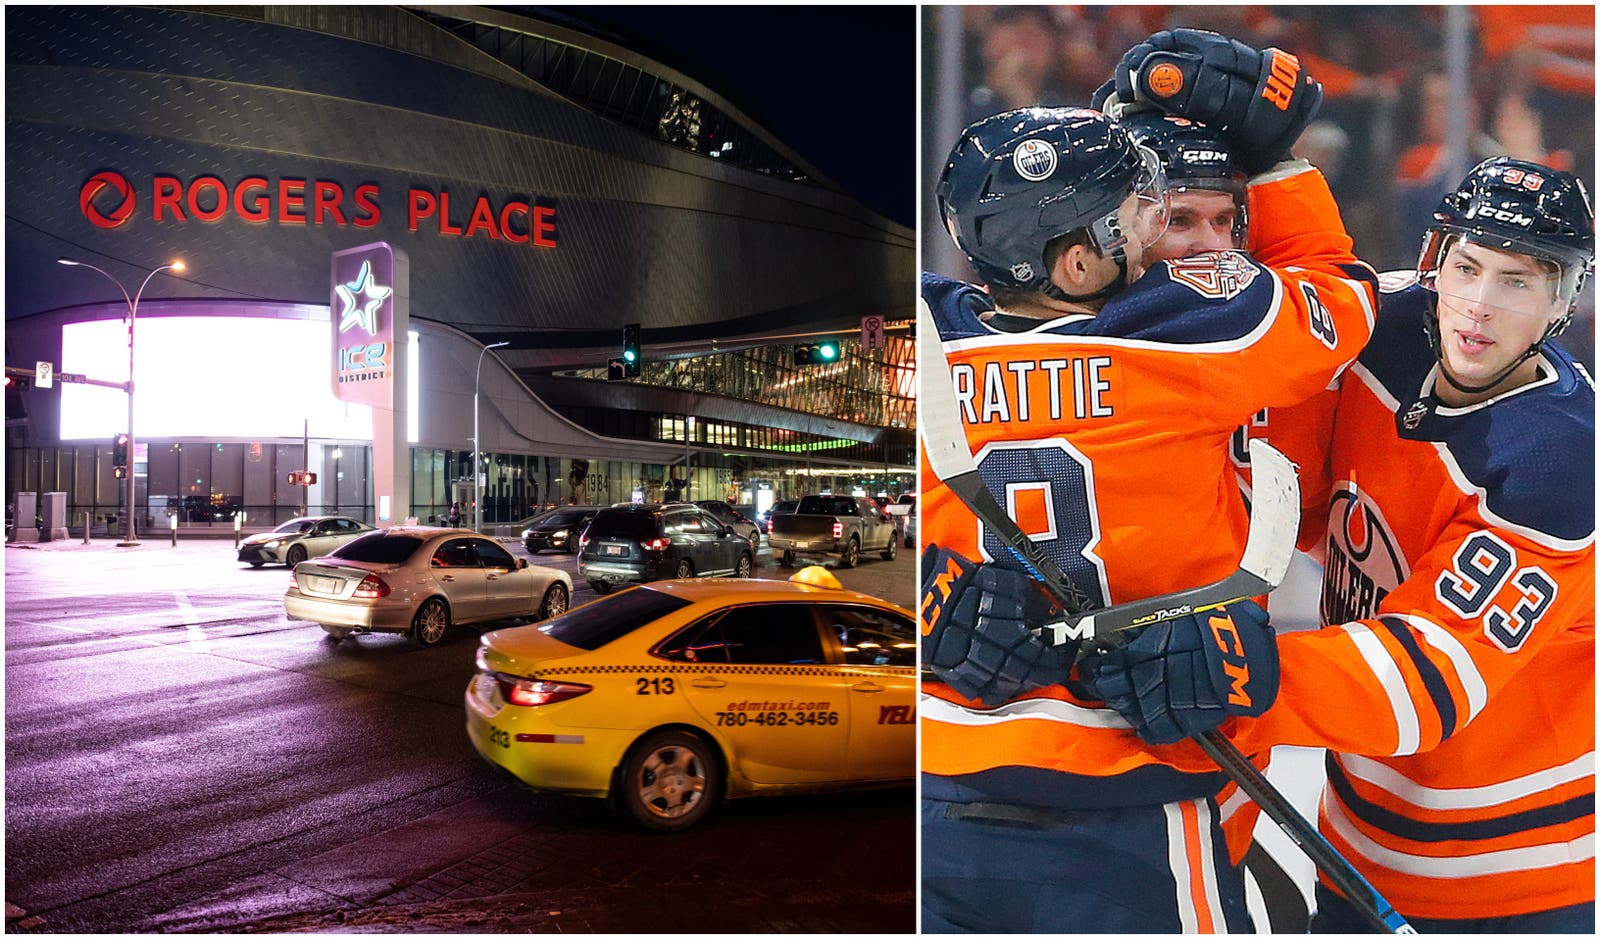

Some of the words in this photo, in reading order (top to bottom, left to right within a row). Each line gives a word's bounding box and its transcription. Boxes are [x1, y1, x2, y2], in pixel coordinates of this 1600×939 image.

[152, 176, 382, 227] ROGERS
[408, 189, 557, 248] PLACE
[1478, 205, 1532, 226] CCM
[338, 371, 385, 383] DISTRICT
[953, 356, 1114, 424] RATTIE
[586, 474, 608, 493] 1984
[1434, 529, 1559, 654] 93
[1153, 604, 1192, 622] TACKS
[1208, 605, 1253, 708] CM
[636, 678, 675, 695] 213
[727, 700, 831, 711] edmtaxi.com
[716, 712, 839, 726] 780-462-3456
